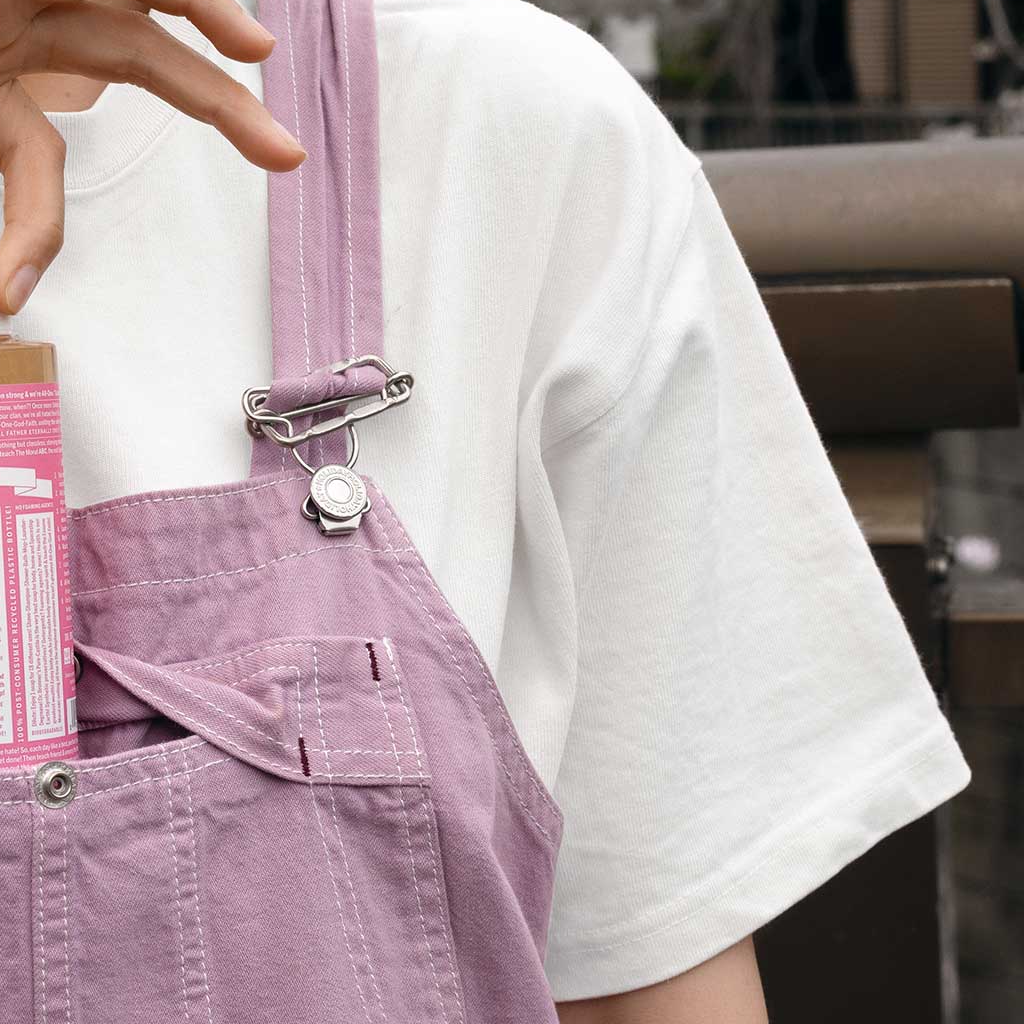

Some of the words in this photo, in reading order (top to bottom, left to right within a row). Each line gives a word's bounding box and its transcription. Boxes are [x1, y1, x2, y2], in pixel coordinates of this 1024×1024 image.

[6, 391, 24, 400] strong
[5, 506, 14, 544] BOTTLE!
[7, 547, 16, 585] PLASTIC
[9, 588, 18, 634] RECYCLED
[12, 638, 23, 714] POST-CONSUMER
[6, 756, 22, 764] done!
